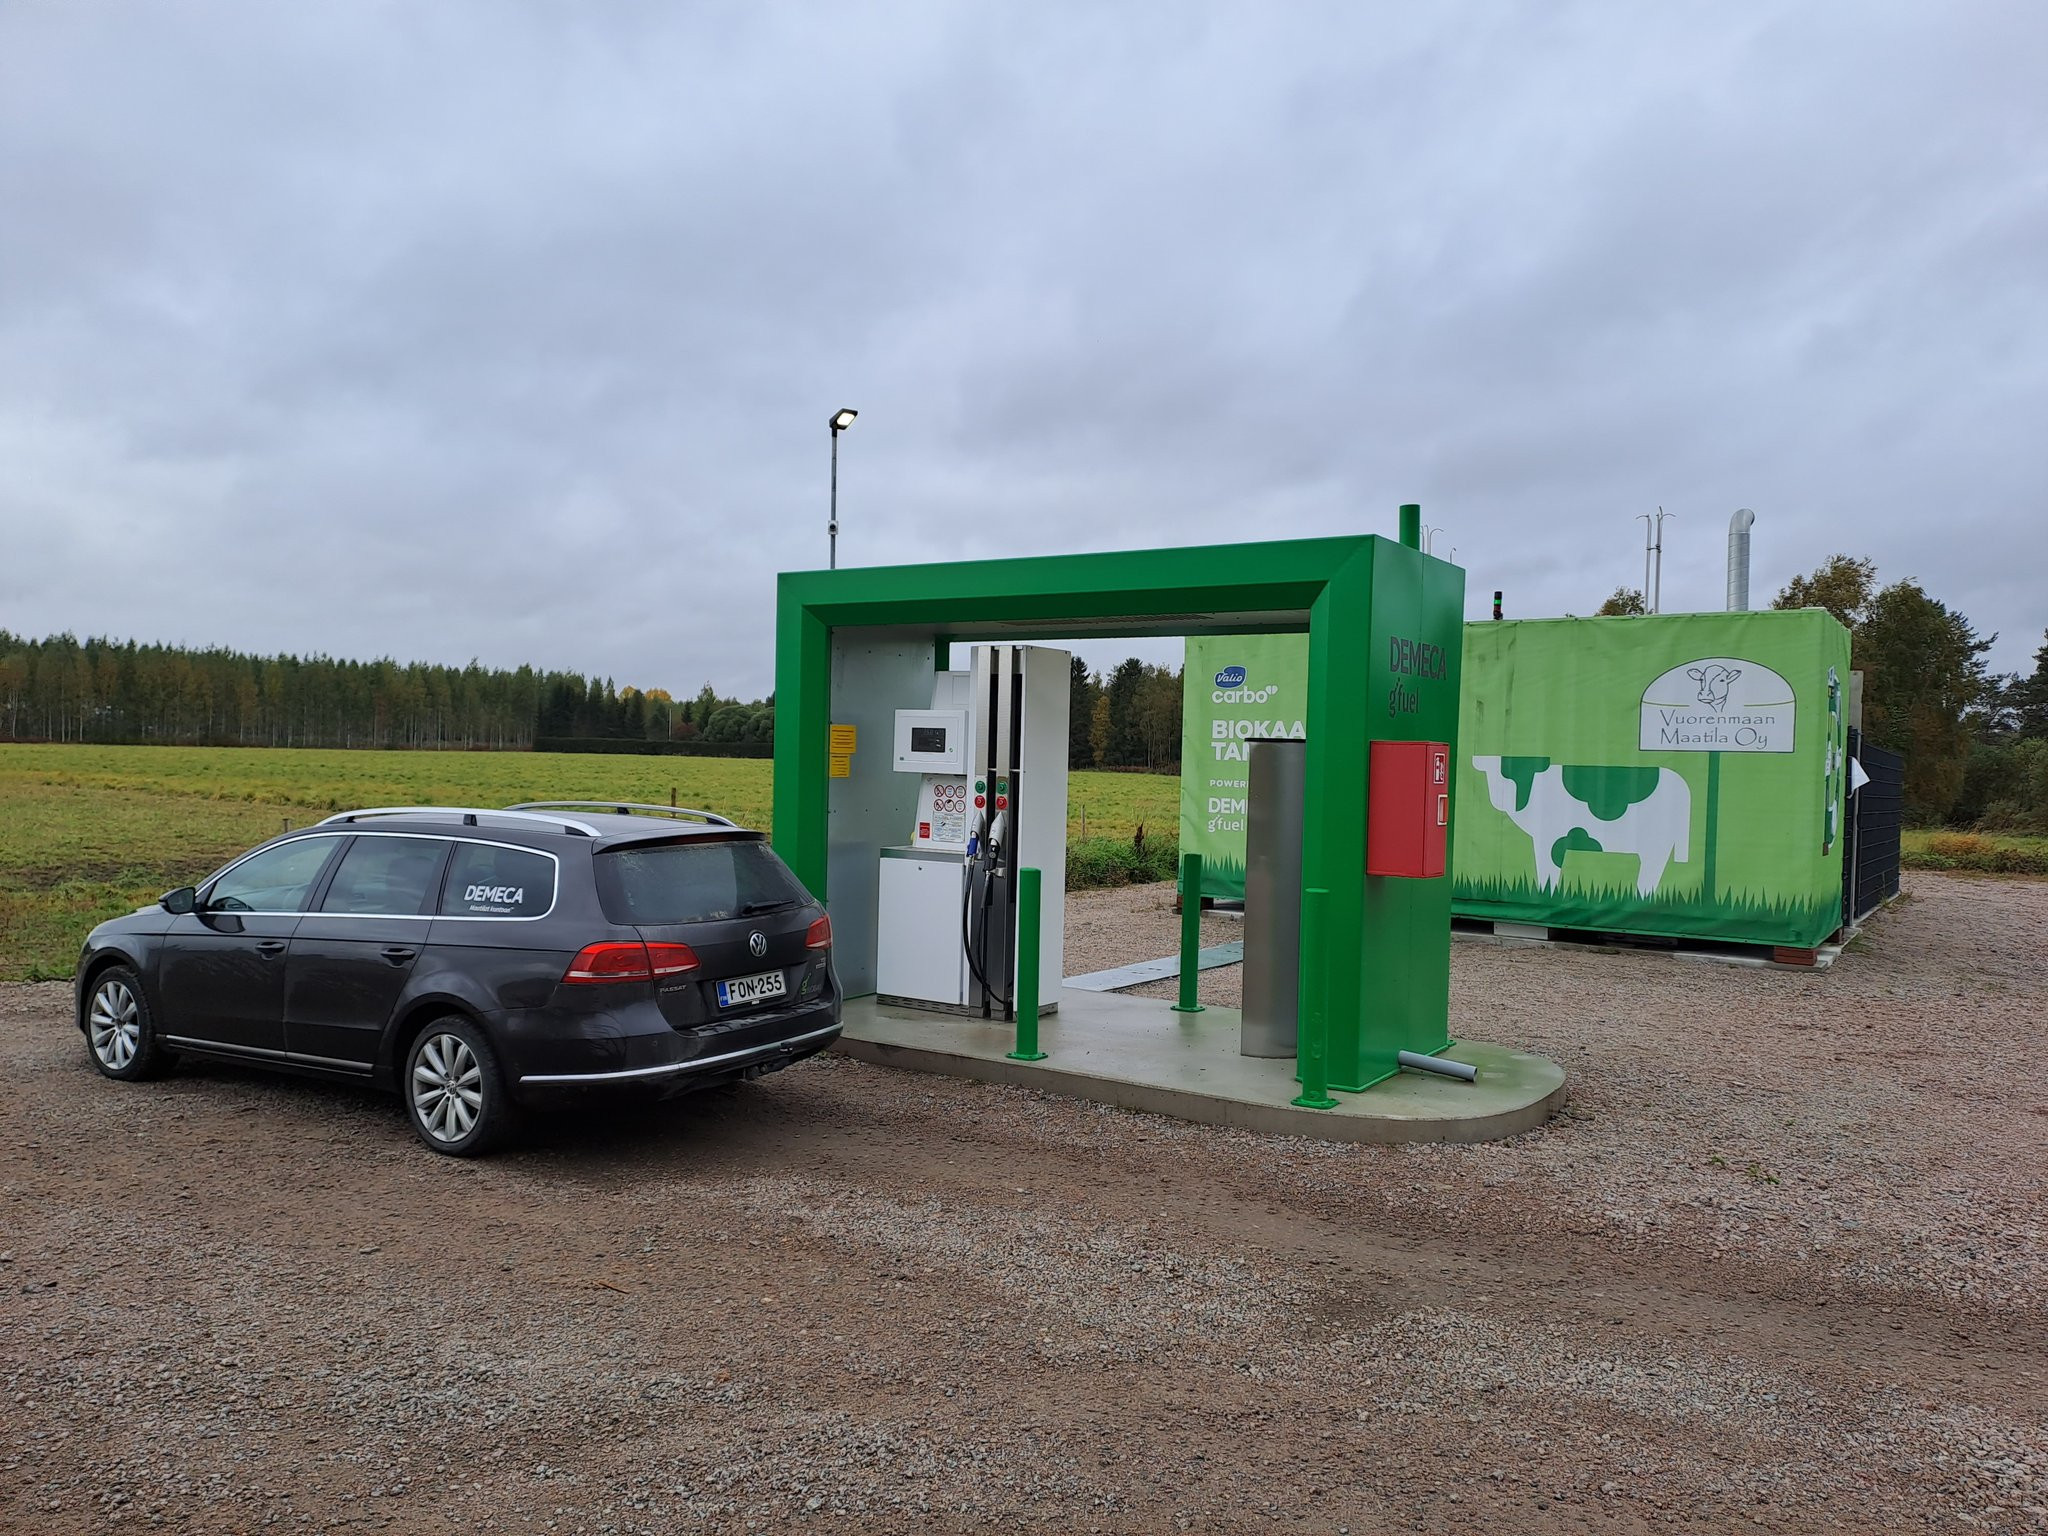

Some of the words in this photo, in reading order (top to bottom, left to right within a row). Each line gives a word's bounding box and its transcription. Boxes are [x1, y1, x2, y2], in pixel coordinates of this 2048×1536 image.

[1390, 636, 1447, 680] DEMECA
[1216, 673, 1243, 682] Valio
[1211, 685, 1268, 704] carbo
[1660, 709, 1775, 726] Vuorenmaan
[1660, 727, 1728, 744] Maatila
[1735, 727, 1768, 750] Oy
[1209, 779, 1249, 788] POWER
[1208, 797, 1248, 814] DEM
[464, 884, 523, 904] DEMECA
[729, 974, 783, 1001] FON-255
